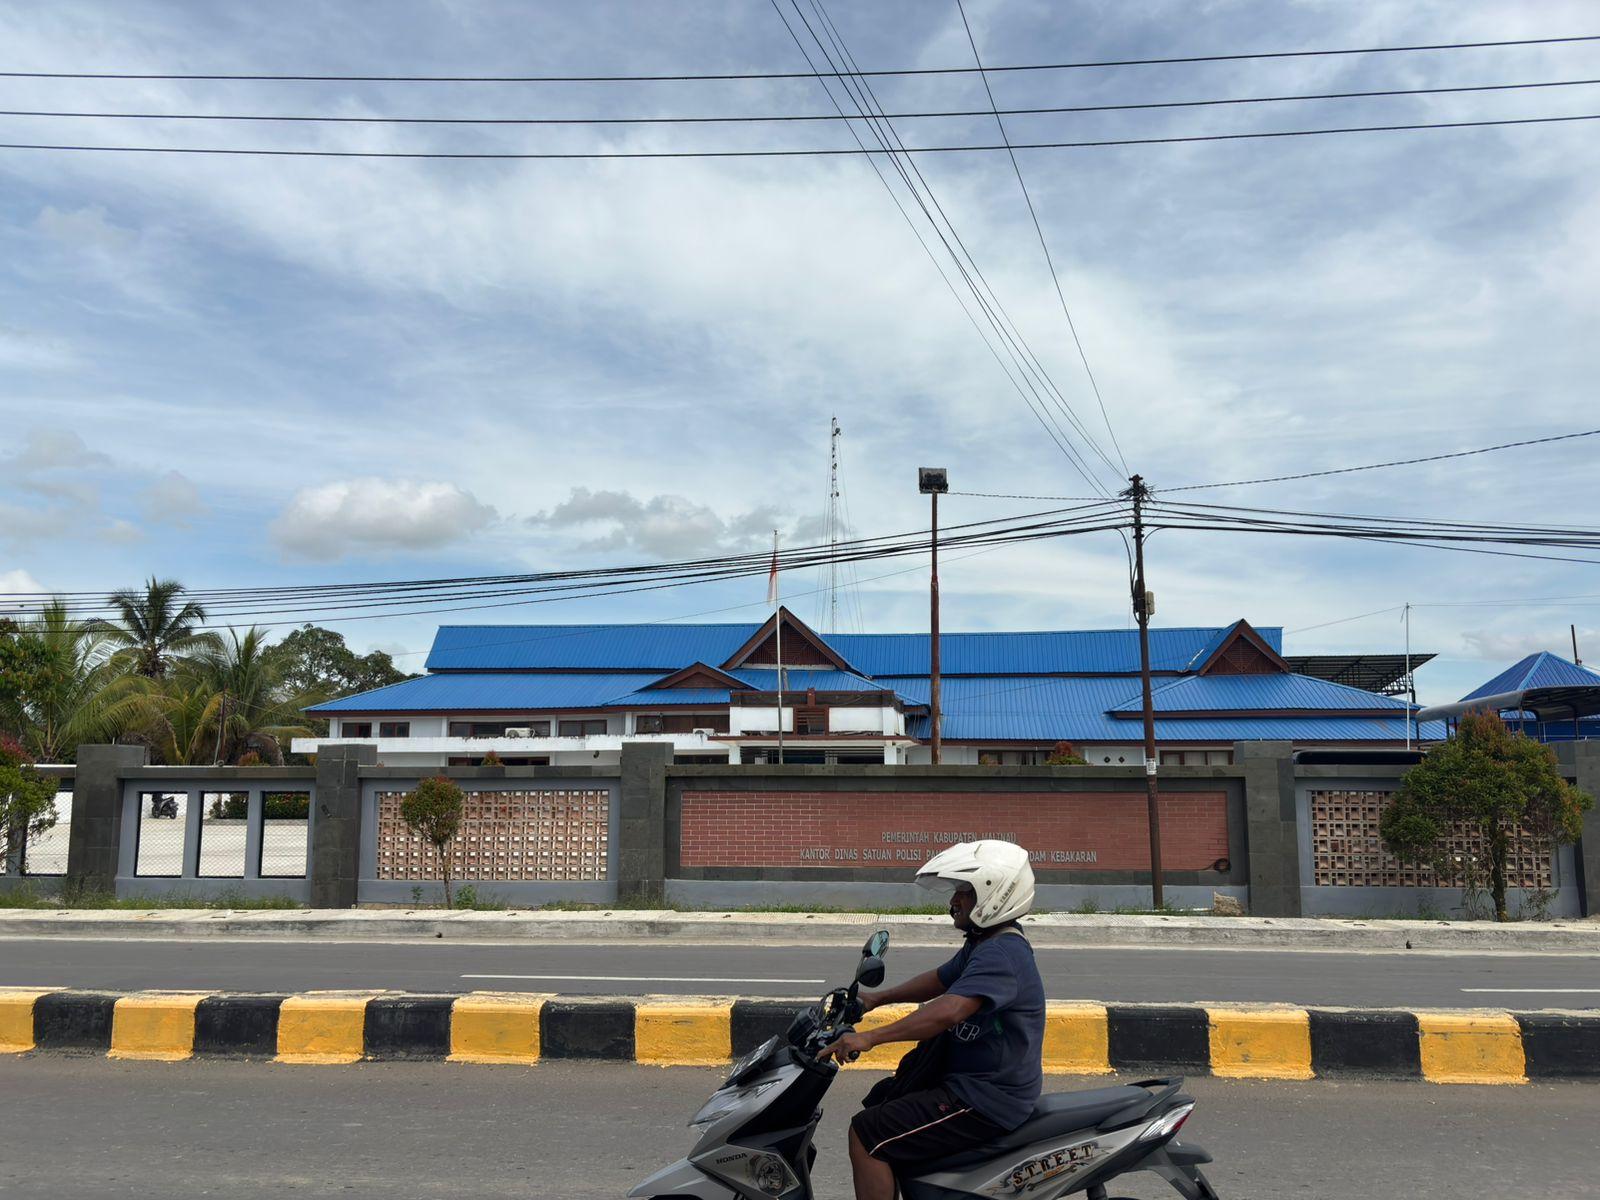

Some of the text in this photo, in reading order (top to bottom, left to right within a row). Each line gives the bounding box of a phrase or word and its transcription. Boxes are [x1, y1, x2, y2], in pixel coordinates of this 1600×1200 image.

[881, 831, 929, 843] PEMERINTAH
[933, 832, 977, 844] KABUPATEN
[800, 848, 831, 860] KANTOR
[834, 848, 858, 860] DINAS
[862, 849, 892, 861] SATUAN
[896, 849, 921, 861] POLISI
[1050, 850, 1097, 863] KEBAKARAN
[715, 1152, 748, 1165] HONDA
[1012, 1143, 1096, 1189] STREET
